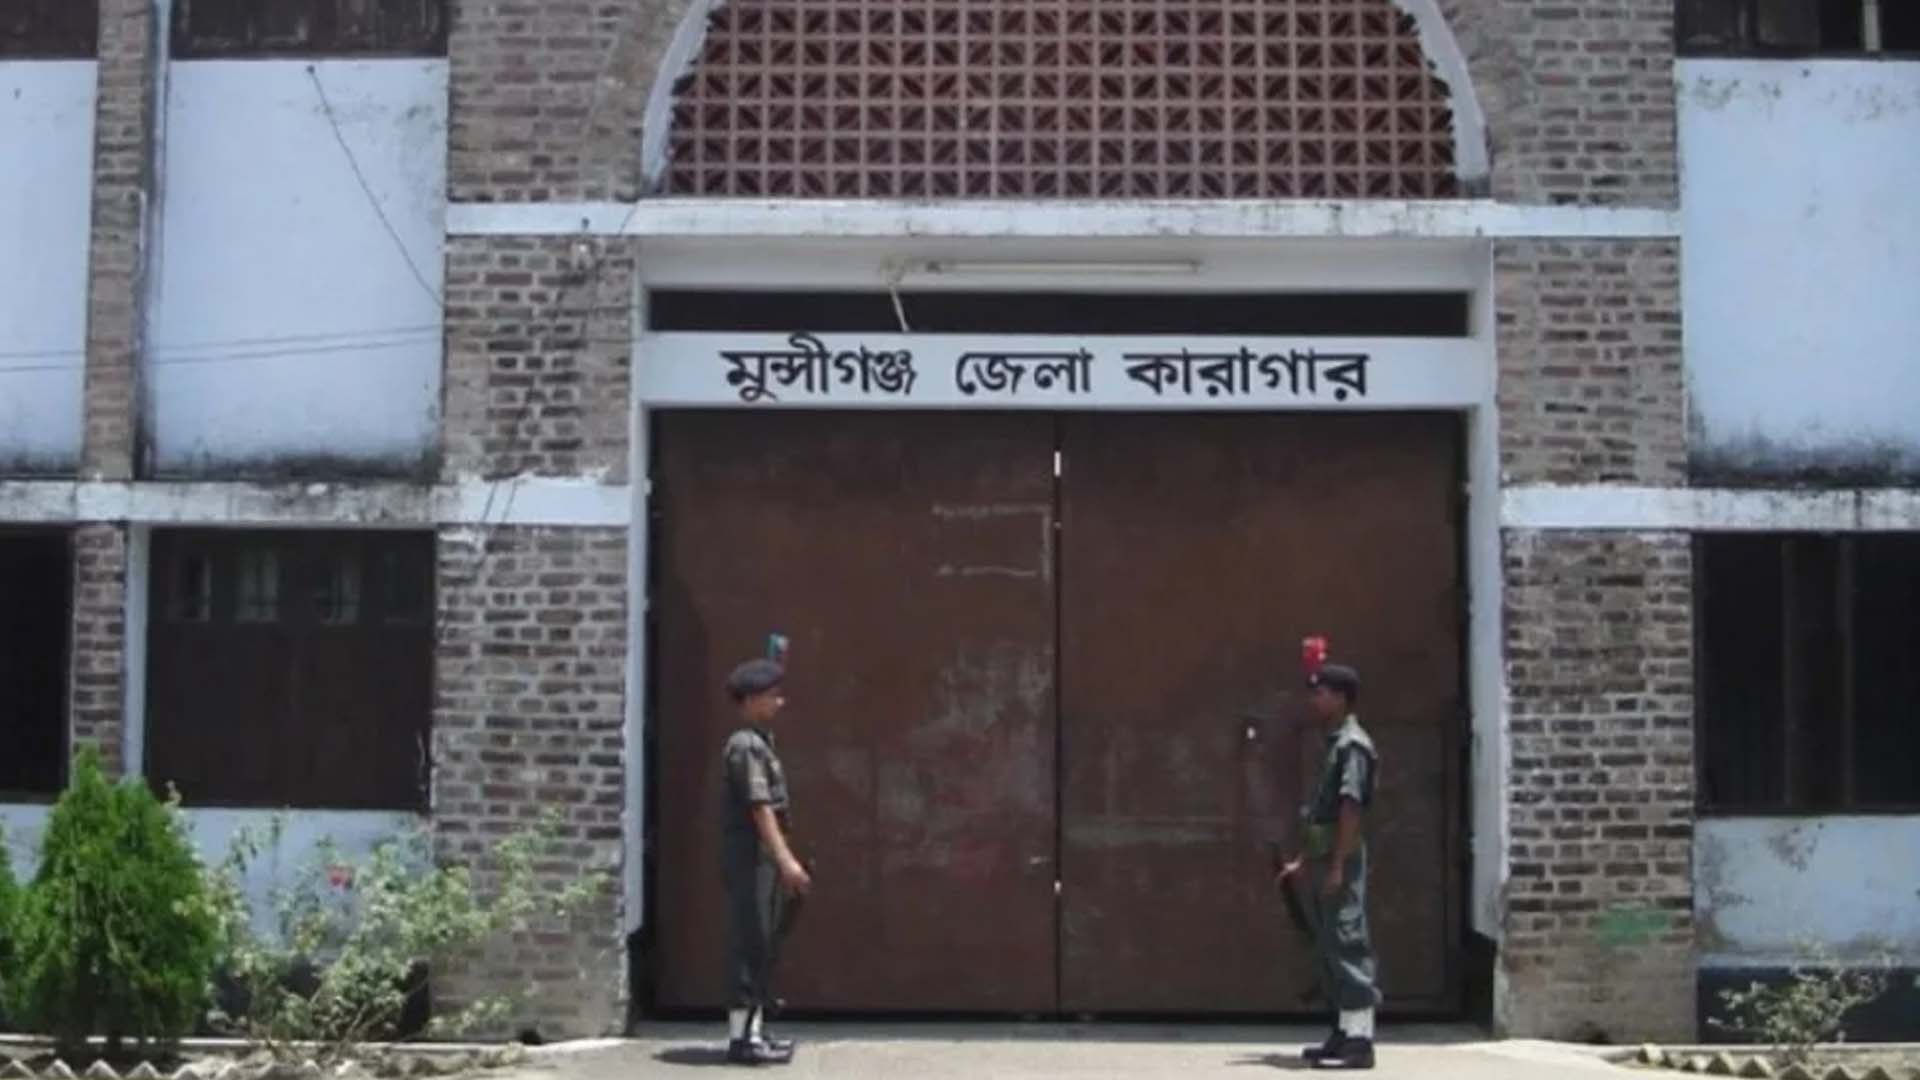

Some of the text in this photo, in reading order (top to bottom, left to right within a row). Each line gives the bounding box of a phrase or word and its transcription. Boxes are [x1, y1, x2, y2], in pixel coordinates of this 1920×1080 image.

[720, 332, 1370, 401] মুন্সীগঞ্জ জেলা কারাগার
